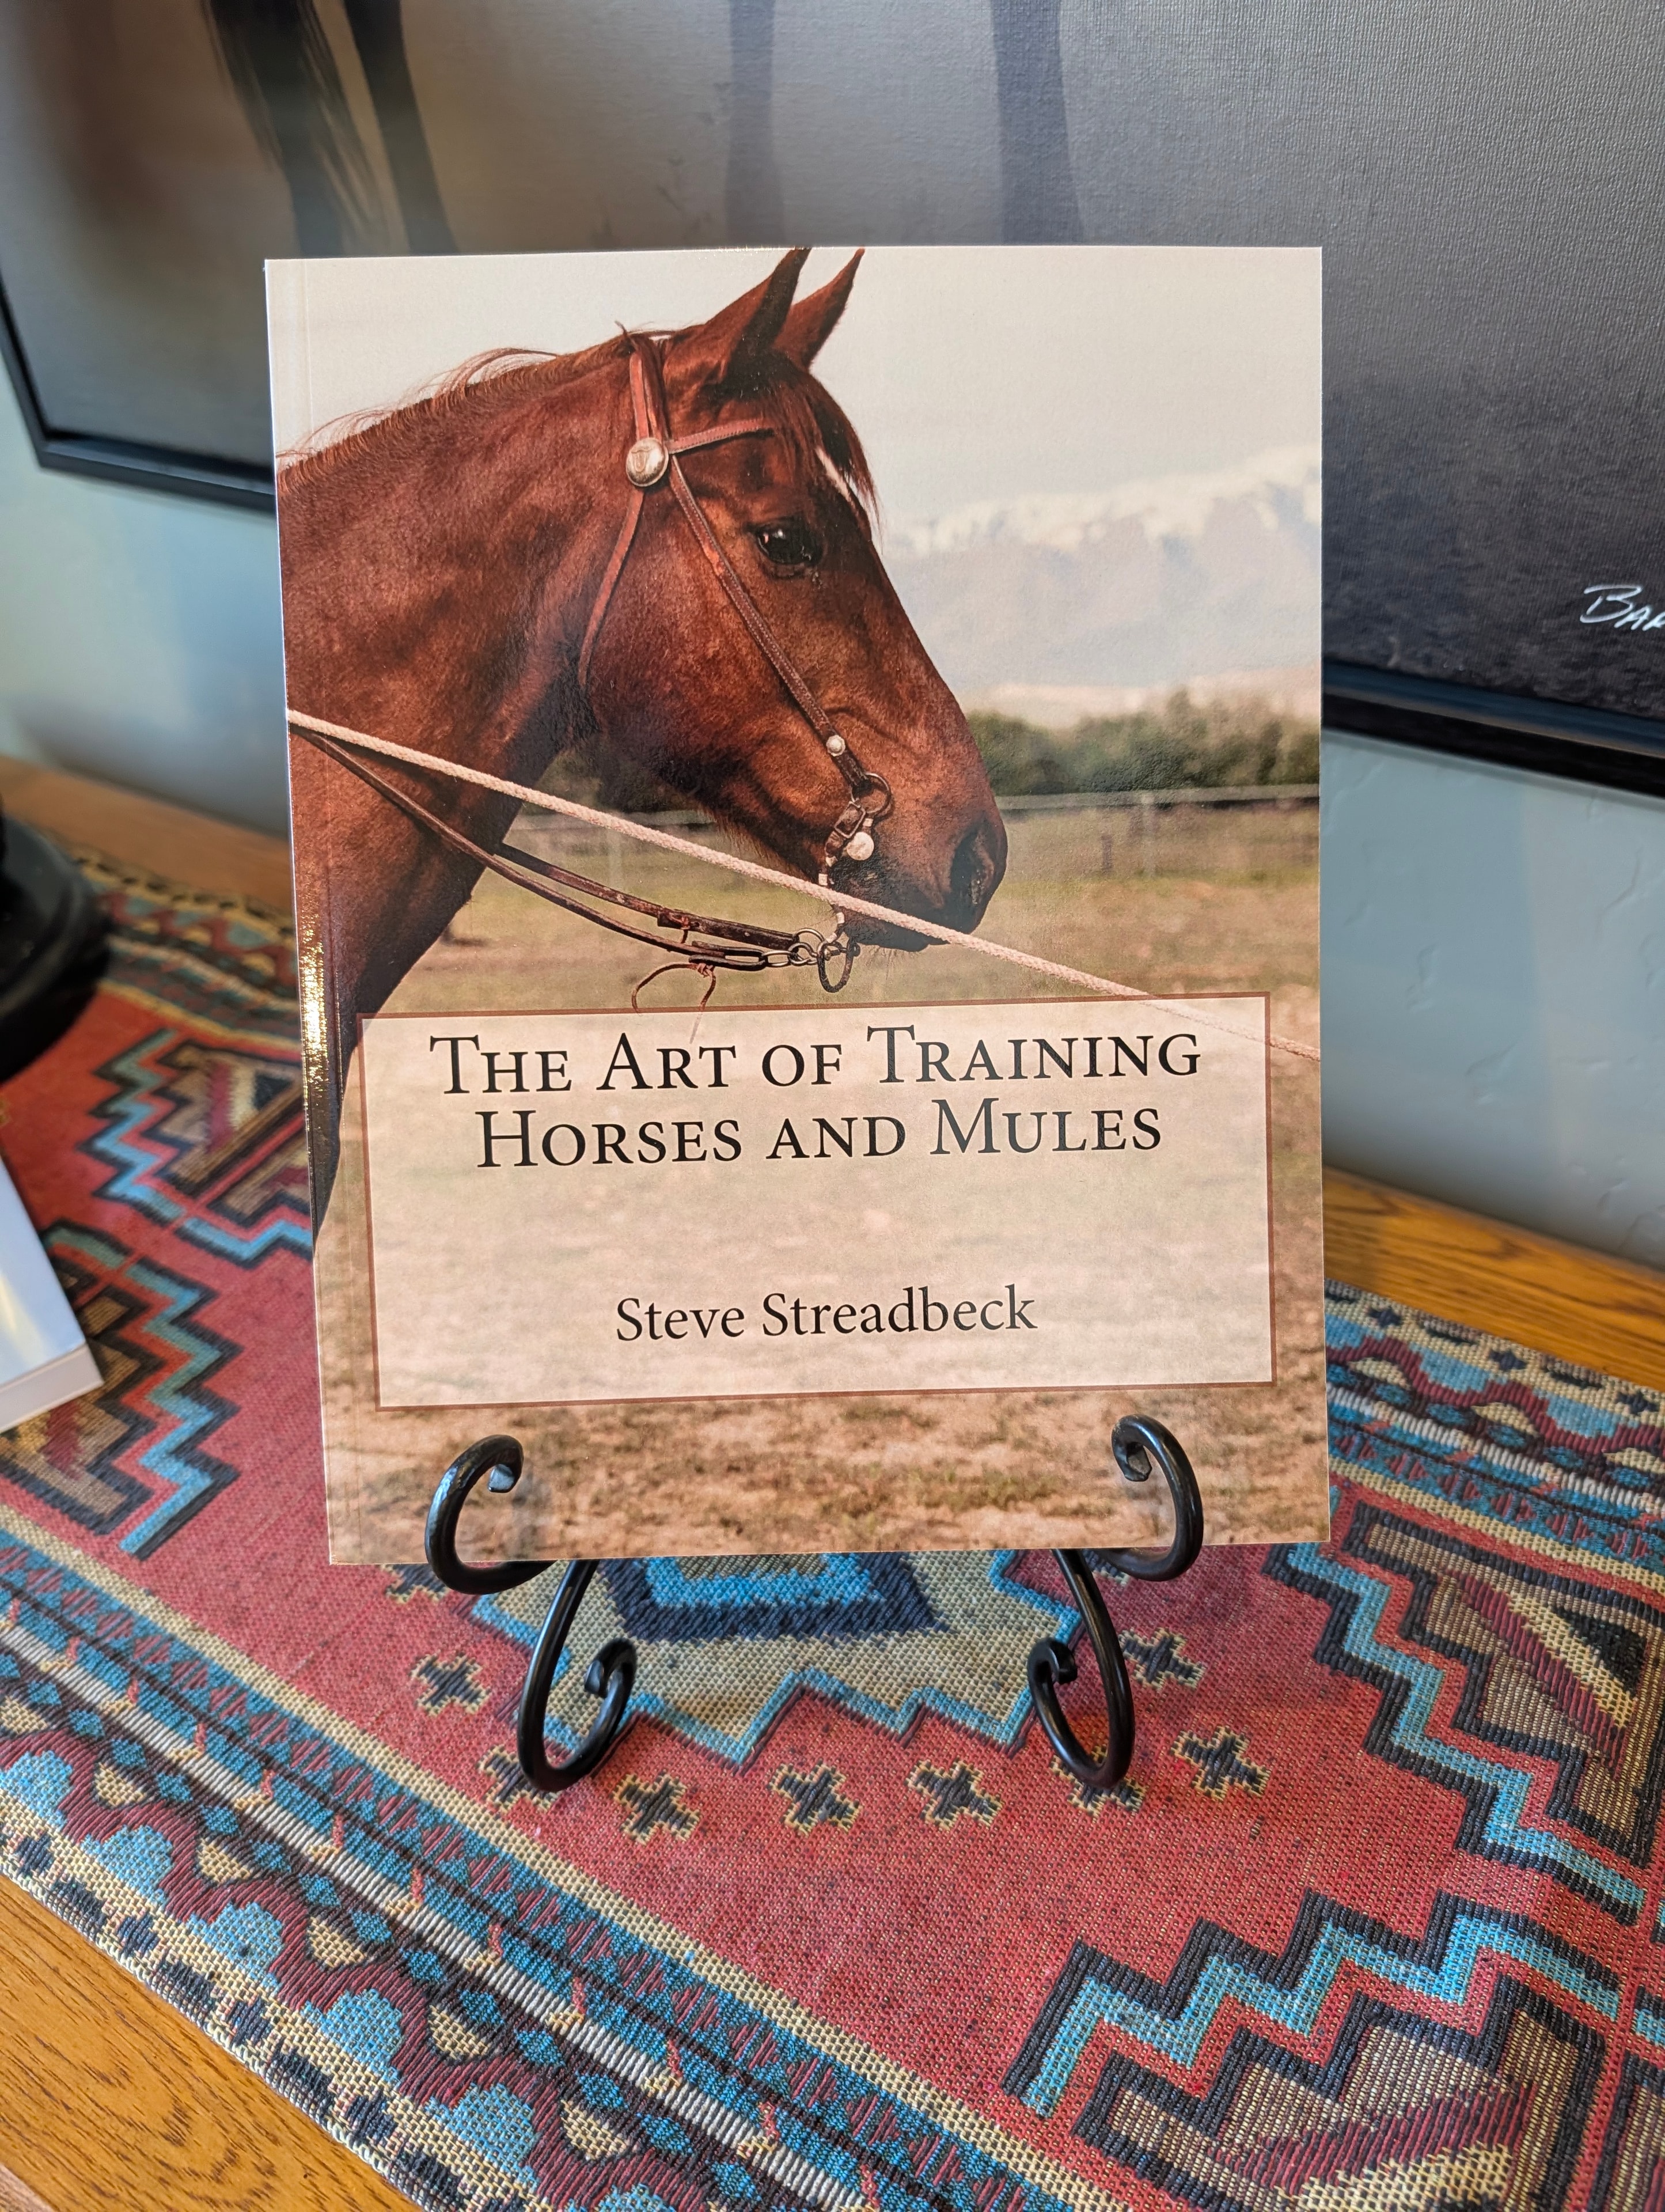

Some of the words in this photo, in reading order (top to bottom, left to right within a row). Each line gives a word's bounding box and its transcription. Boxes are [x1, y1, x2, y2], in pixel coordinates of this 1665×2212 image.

[430, 1034, 572, 1094] THE
[596, 1032, 737, 1090] ART
[761, 1044, 843, 1087] OF
[867, 1024, 1201, 1084] TRAINING
[475, 1109, 742, 1168] HORSES
[765, 1116, 906, 1160] AND
[929, 1097, 1162, 1155] MULES
[616, 1297, 745, 1342] Steve
[761, 1283, 1038, 1337] Streadbeck
